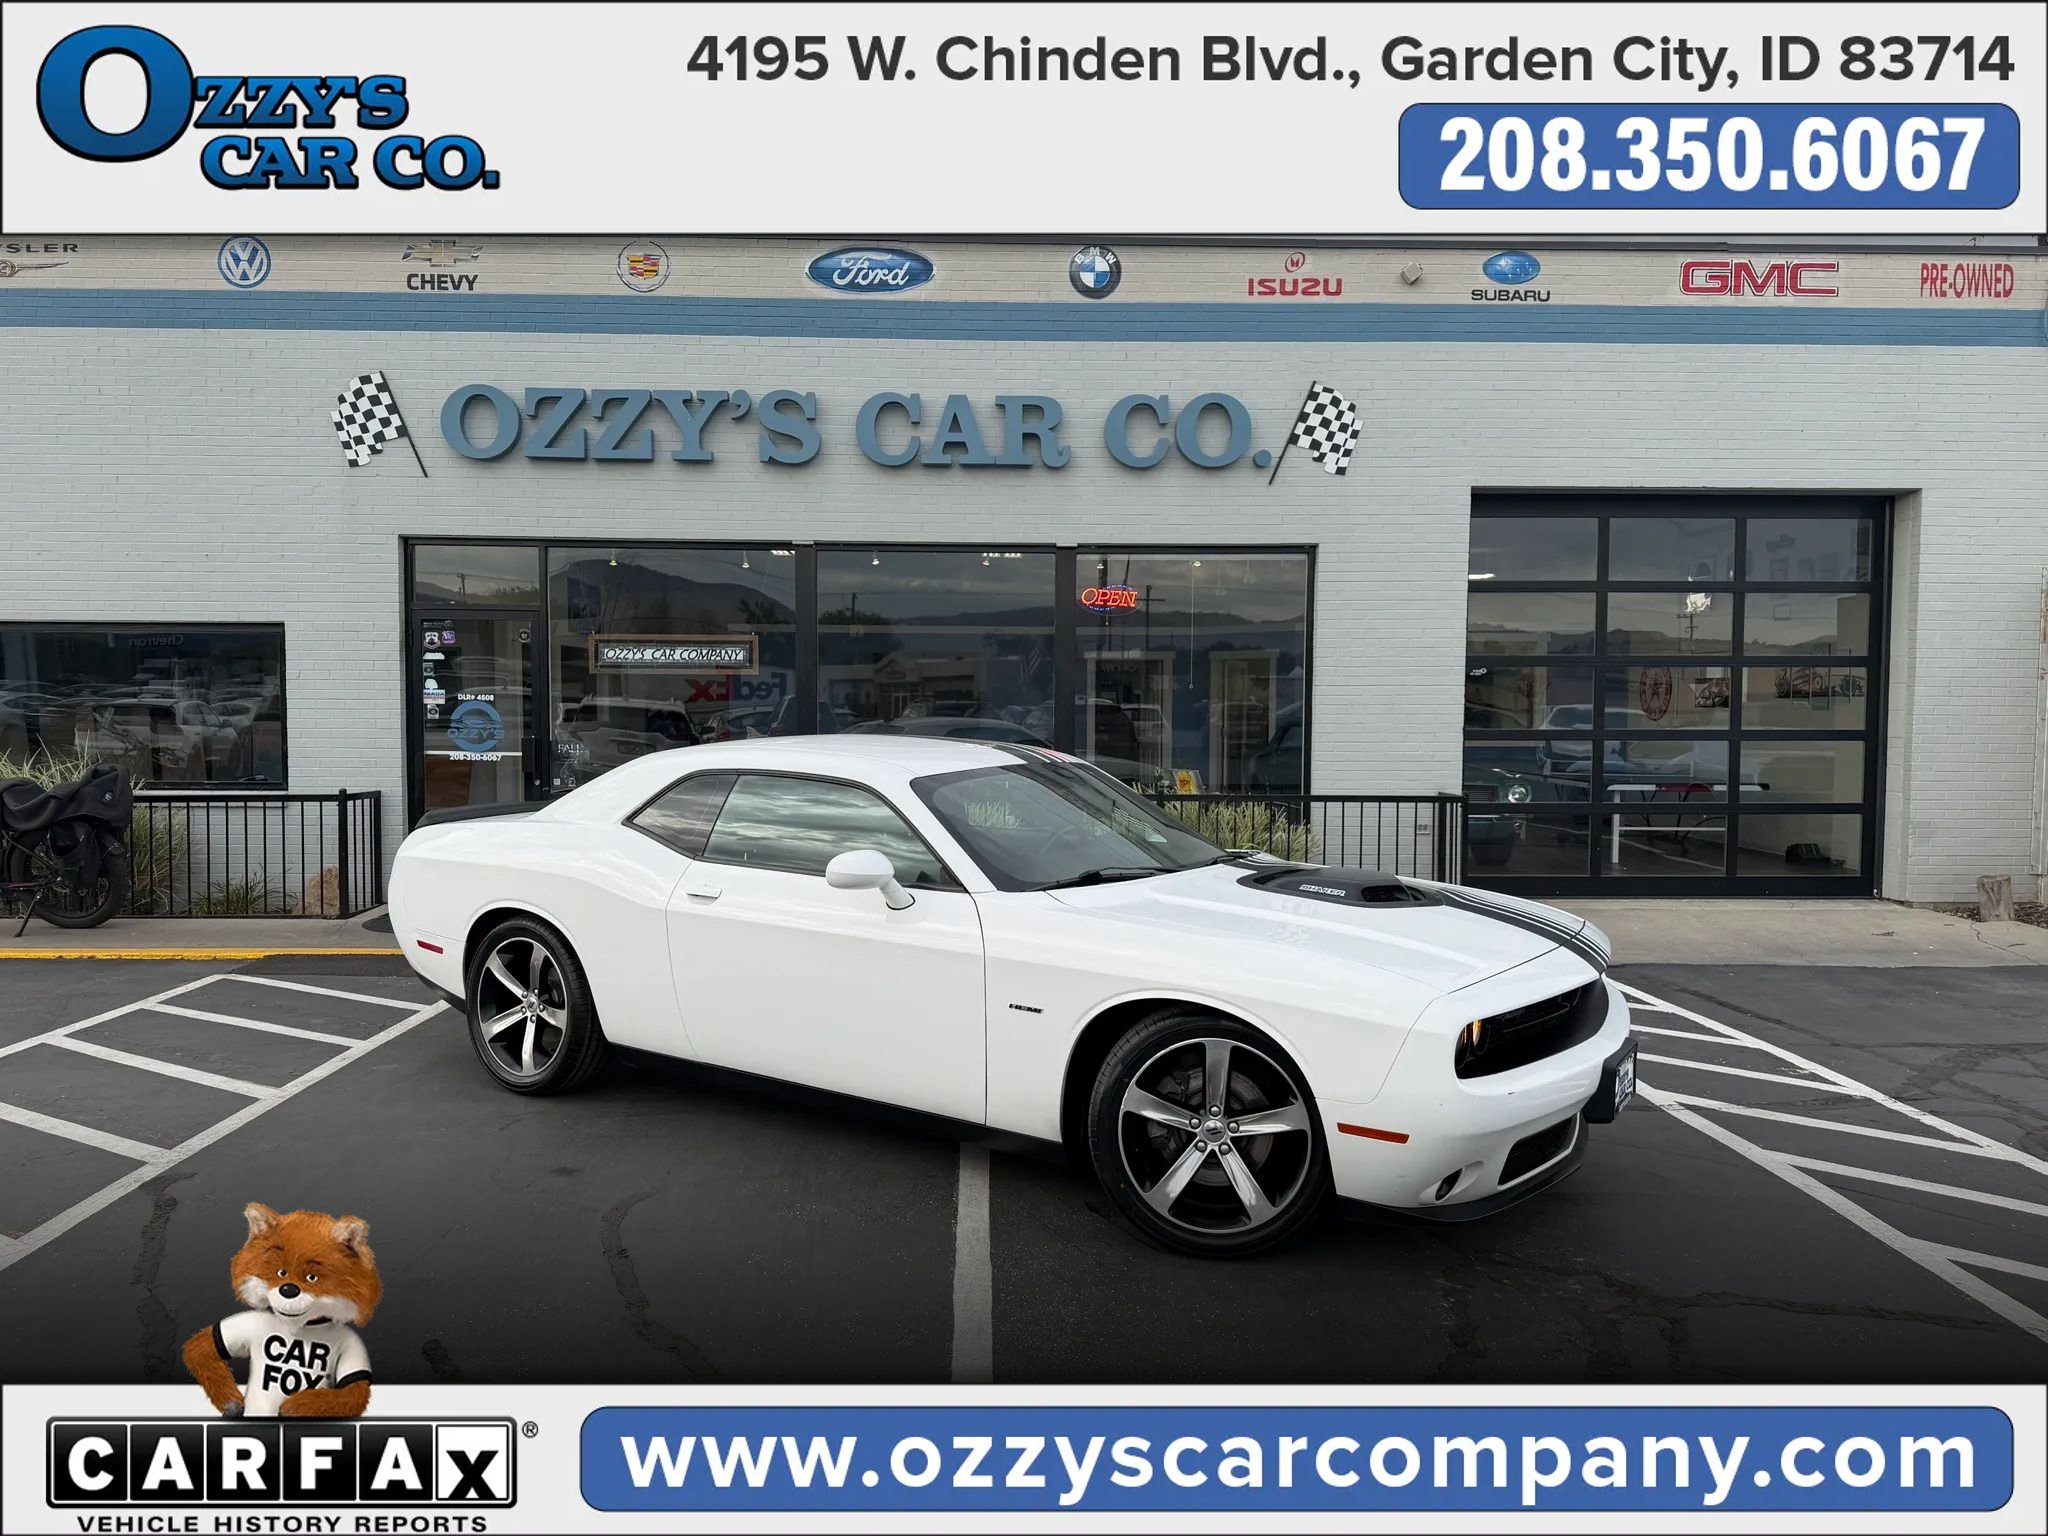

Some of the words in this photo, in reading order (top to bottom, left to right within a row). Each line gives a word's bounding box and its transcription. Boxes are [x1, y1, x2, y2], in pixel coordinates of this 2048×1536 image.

[0, 243, 79, 253] SLER
[1074, 246, 1117, 265] BMW
[832, 254, 910, 286] Ford
[1680, 260, 1839, 297] GMC
[406, 273, 478, 291] CHEVY
[1248, 277, 1342, 297] ISUZU
[1920, 263, 2014, 298] PRE-OWNED
[1471, 289, 1550, 302] SUBARU
[440, 384, 821, 464] OZZY'S
[854, 393, 1072, 467] CAR
[1105, 393, 1272, 467] CO.
[1081, 587, 1138, 607] OPEN
[605, 649, 645, 660] OZZY'S
[651, 649, 676, 660] CAR
[679, 649, 742, 661] COMPANY
[447, 728, 504, 739] OZZY'S
[449, 753, 502, 762] 208-350-6067
